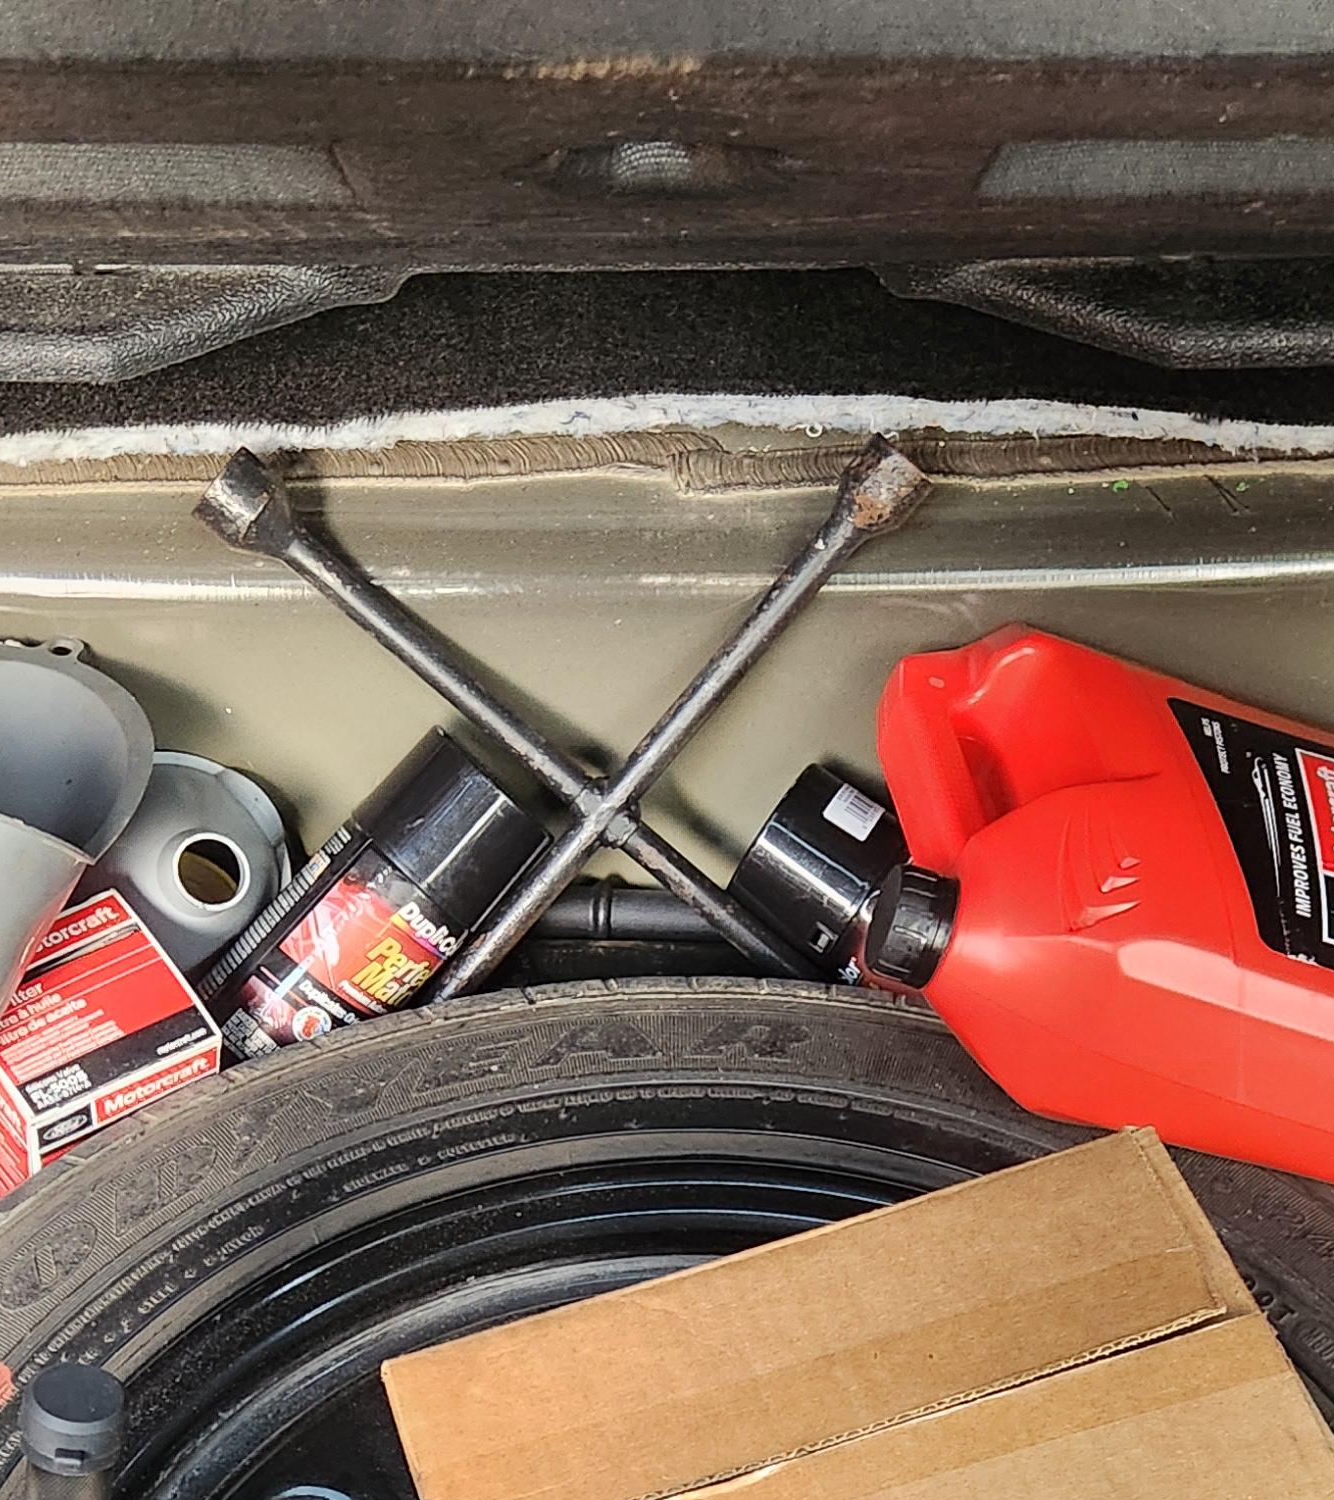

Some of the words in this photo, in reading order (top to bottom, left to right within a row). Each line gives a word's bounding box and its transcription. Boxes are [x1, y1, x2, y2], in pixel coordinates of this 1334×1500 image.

[1272, 752, 1298, 809] ECONOMY
[1284, 811, 1305, 844] FUEL
[1289, 842, 1312, 918] IMPROVES
[34, 905, 120, 953] torcraft
[365, 935, 431, 988] Perfe
[10, 982, 45, 1007] ilter
[103, 1055, 211, 1116] Motorcraft
